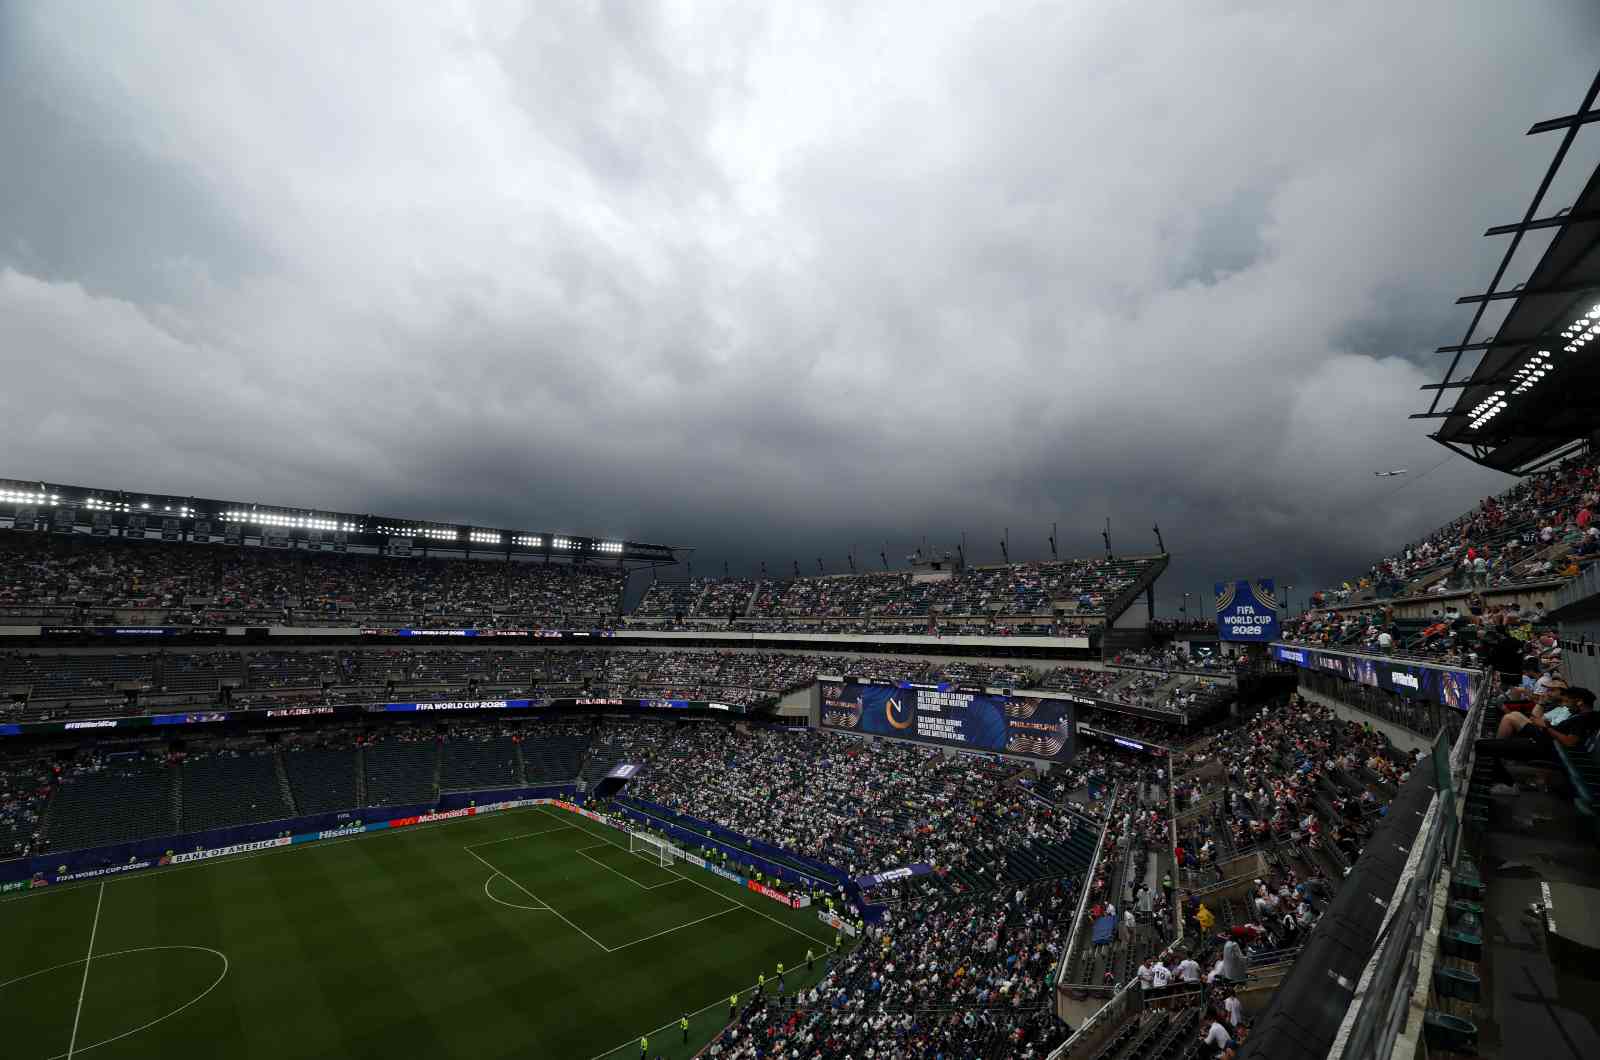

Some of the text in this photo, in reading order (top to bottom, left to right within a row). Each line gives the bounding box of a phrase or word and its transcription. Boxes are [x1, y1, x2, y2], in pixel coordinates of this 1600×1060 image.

[1236, 606, 1255, 615] FIFA
[1224, 616, 1272, 625] WORLD CUP
[1232, 626, 1262, 635] 2026
[416, 703, 434, 711] FIFA
[434, 702, 463, 710] WORLD
[480, 701, 507, 709] 2026
[266, 707, 334, 718] PHILADELPHIA
[319, 825, 367, 839] Hisense
[176, 840, 276, 863] BANK OF AMERICA
[55, 873, 74, 882] FIFA
[75, 868, 105, 879] WORLD
[106, 865, 122, 875] CUP
